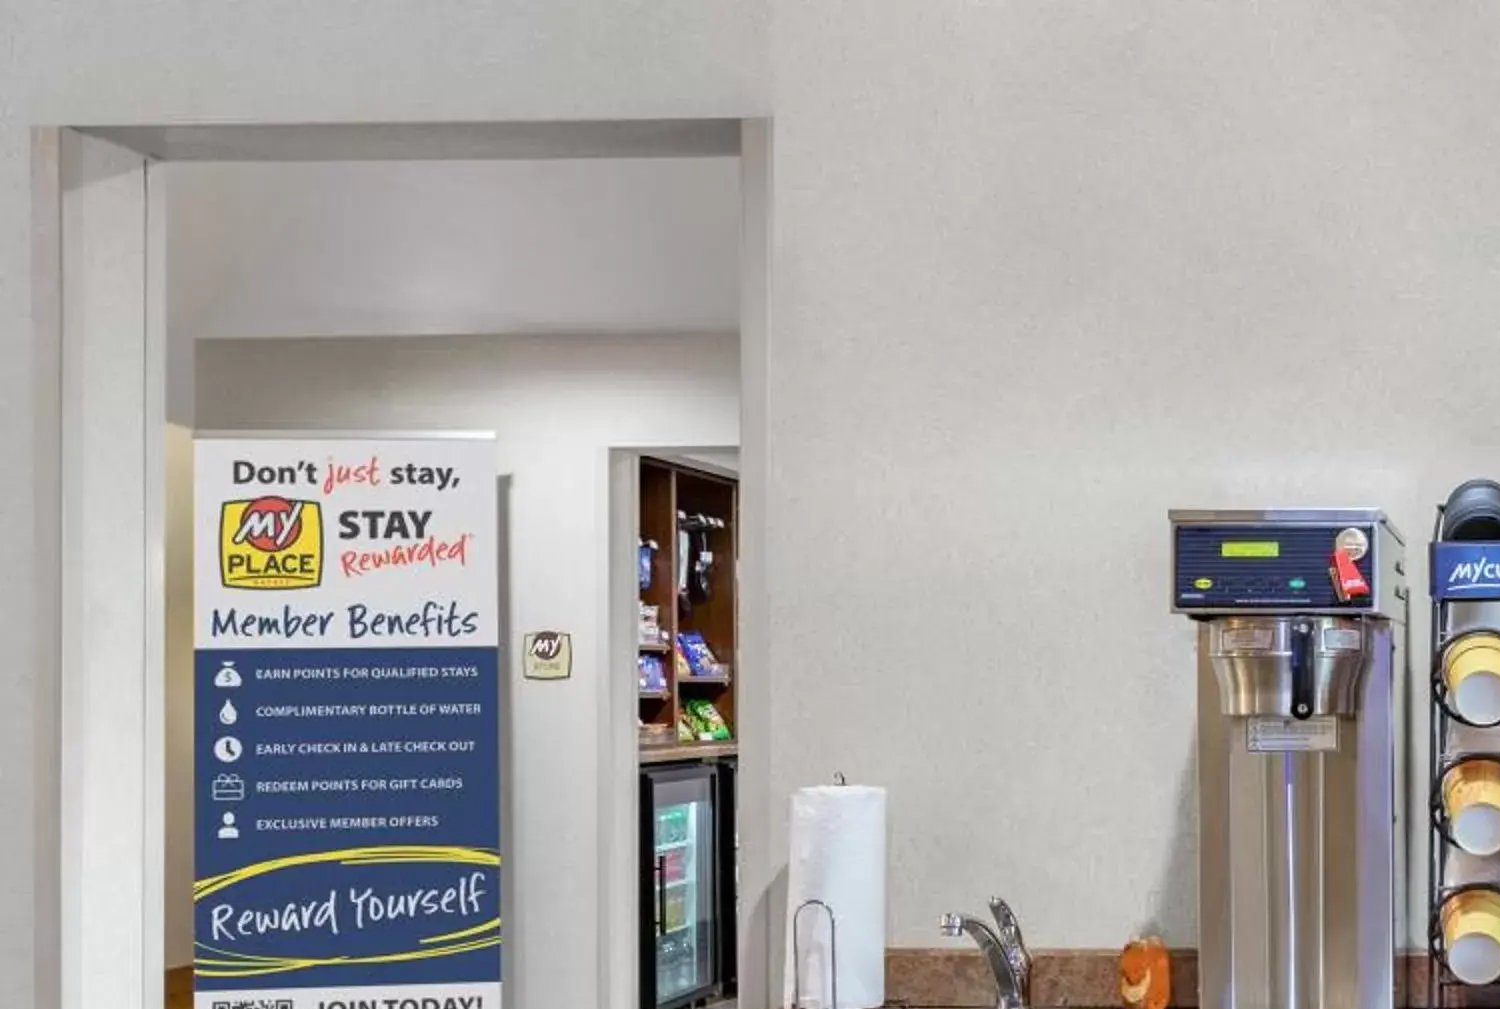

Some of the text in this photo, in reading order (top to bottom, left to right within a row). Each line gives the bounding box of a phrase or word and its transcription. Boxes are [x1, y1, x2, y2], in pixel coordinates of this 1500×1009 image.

[233, 457, 460, 494] Don't just stay,
[338, 510, 432, 539] STAY
[228, 553, 315, 574] PLACE
[341, 534, 467, 577] Rewarded
[211, 601, 479, 639] Member Benefits
[256, 666, 479, 680] EARN POINTS FOR QUALIFIED STAYS
[256, 703, 481, 718] COMPLIMENTARY BOTTLE OF WATER
[256, 740, 476, 756] EARLY CHECK IN & LATE CHECK OUT
[256, 778, 463, 793] REDEEM POINTS FOR GIFT CARDS
[256, 815, 439, 830] EXCLUSIVE MEMBER OFFERS
[211, 871, 486, 941] Reward Yourself
